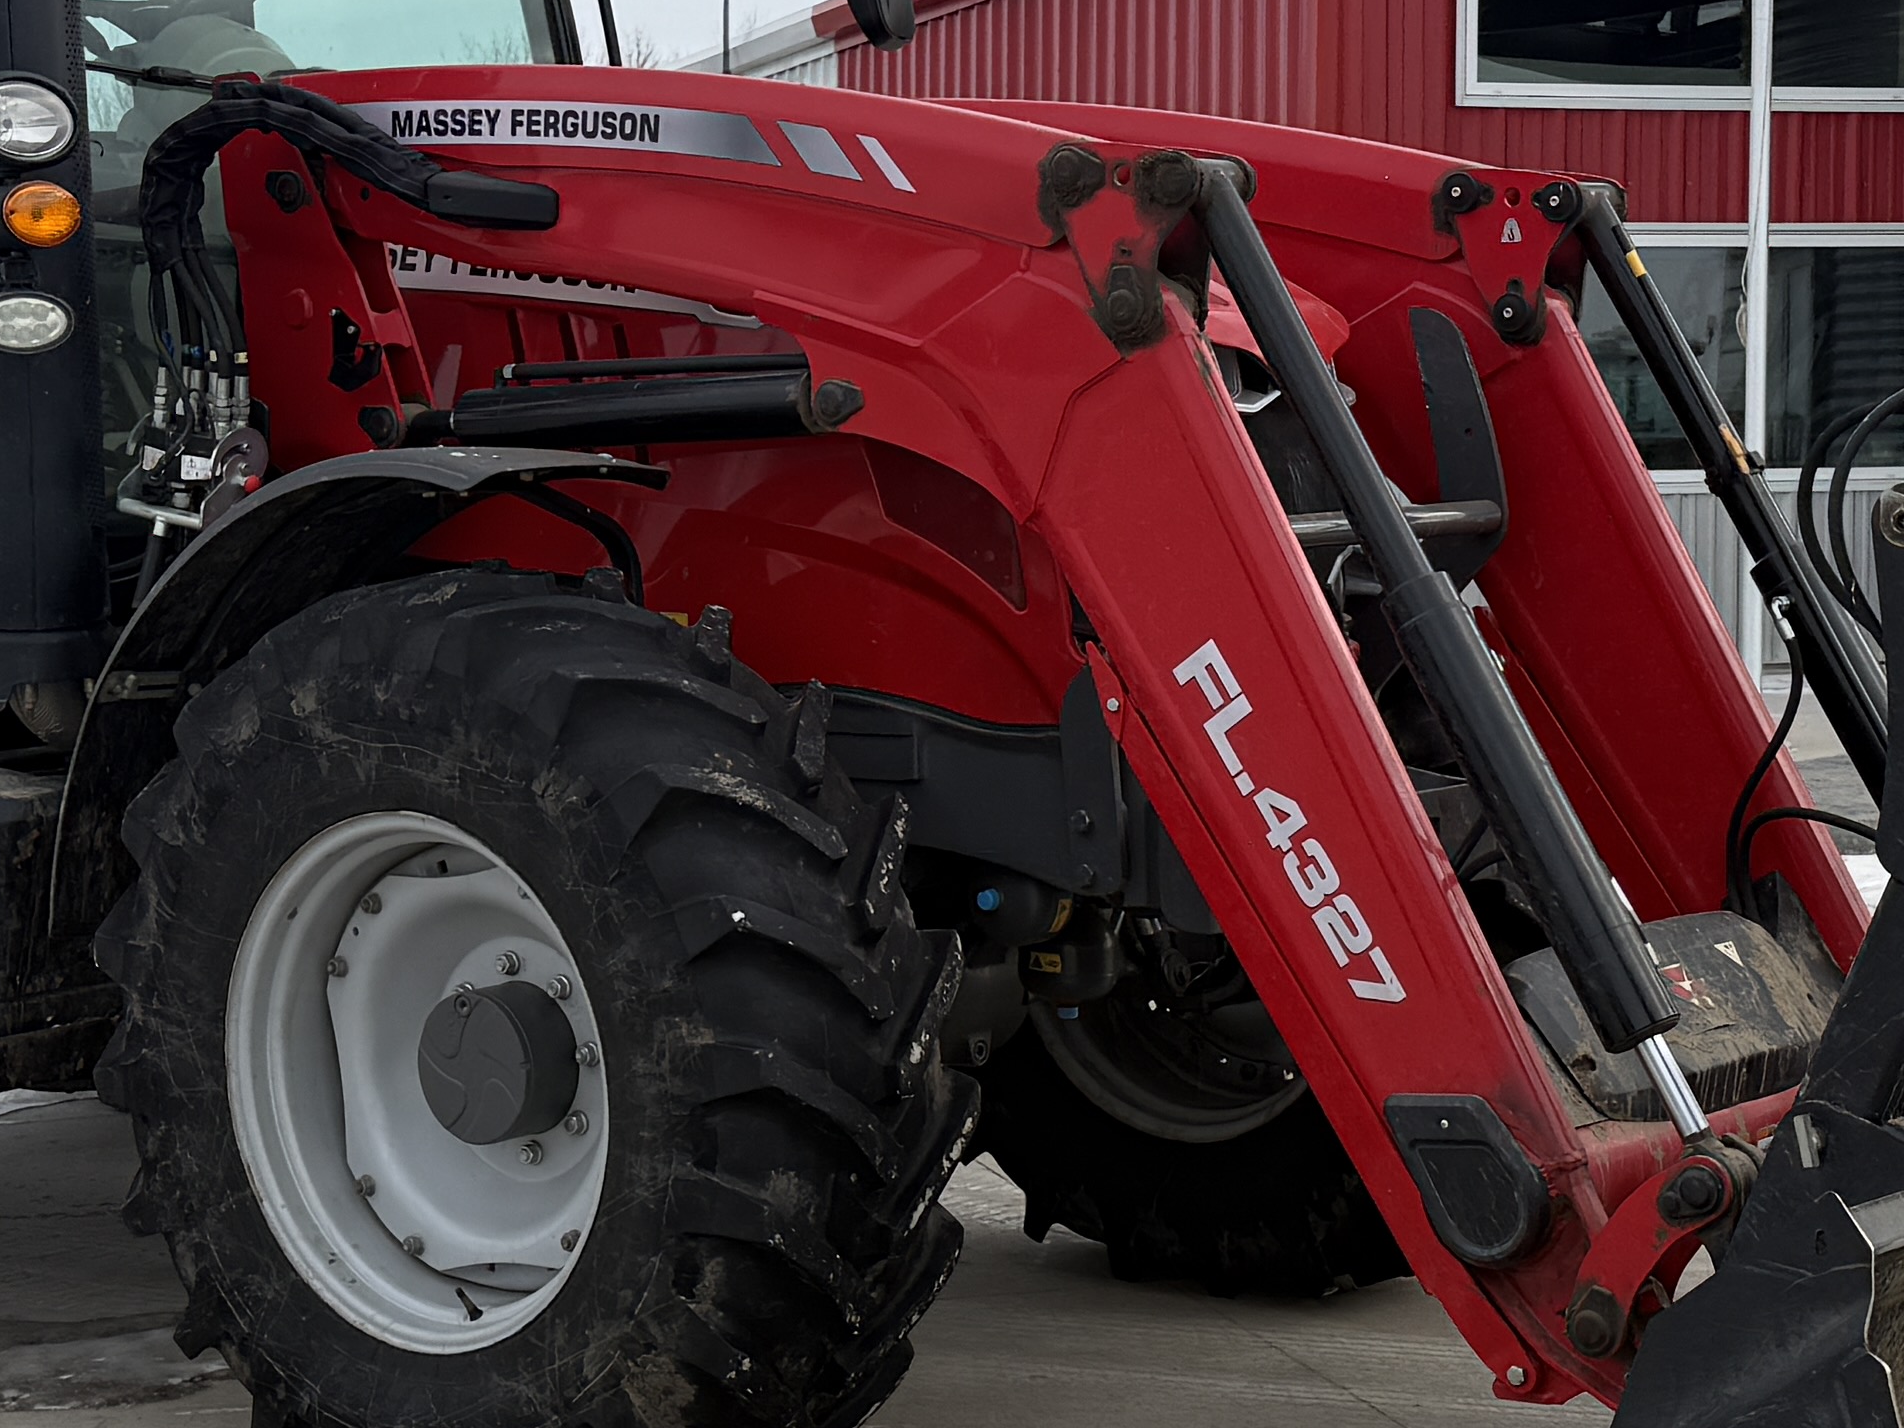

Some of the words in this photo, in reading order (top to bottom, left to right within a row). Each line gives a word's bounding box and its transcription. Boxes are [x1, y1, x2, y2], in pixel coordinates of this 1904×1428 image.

[391, 108, 501, 138] MASSEY
[510, 108, 661, 143] FERGUSON
[1172, 638, 1407, 1004] FL.4327
